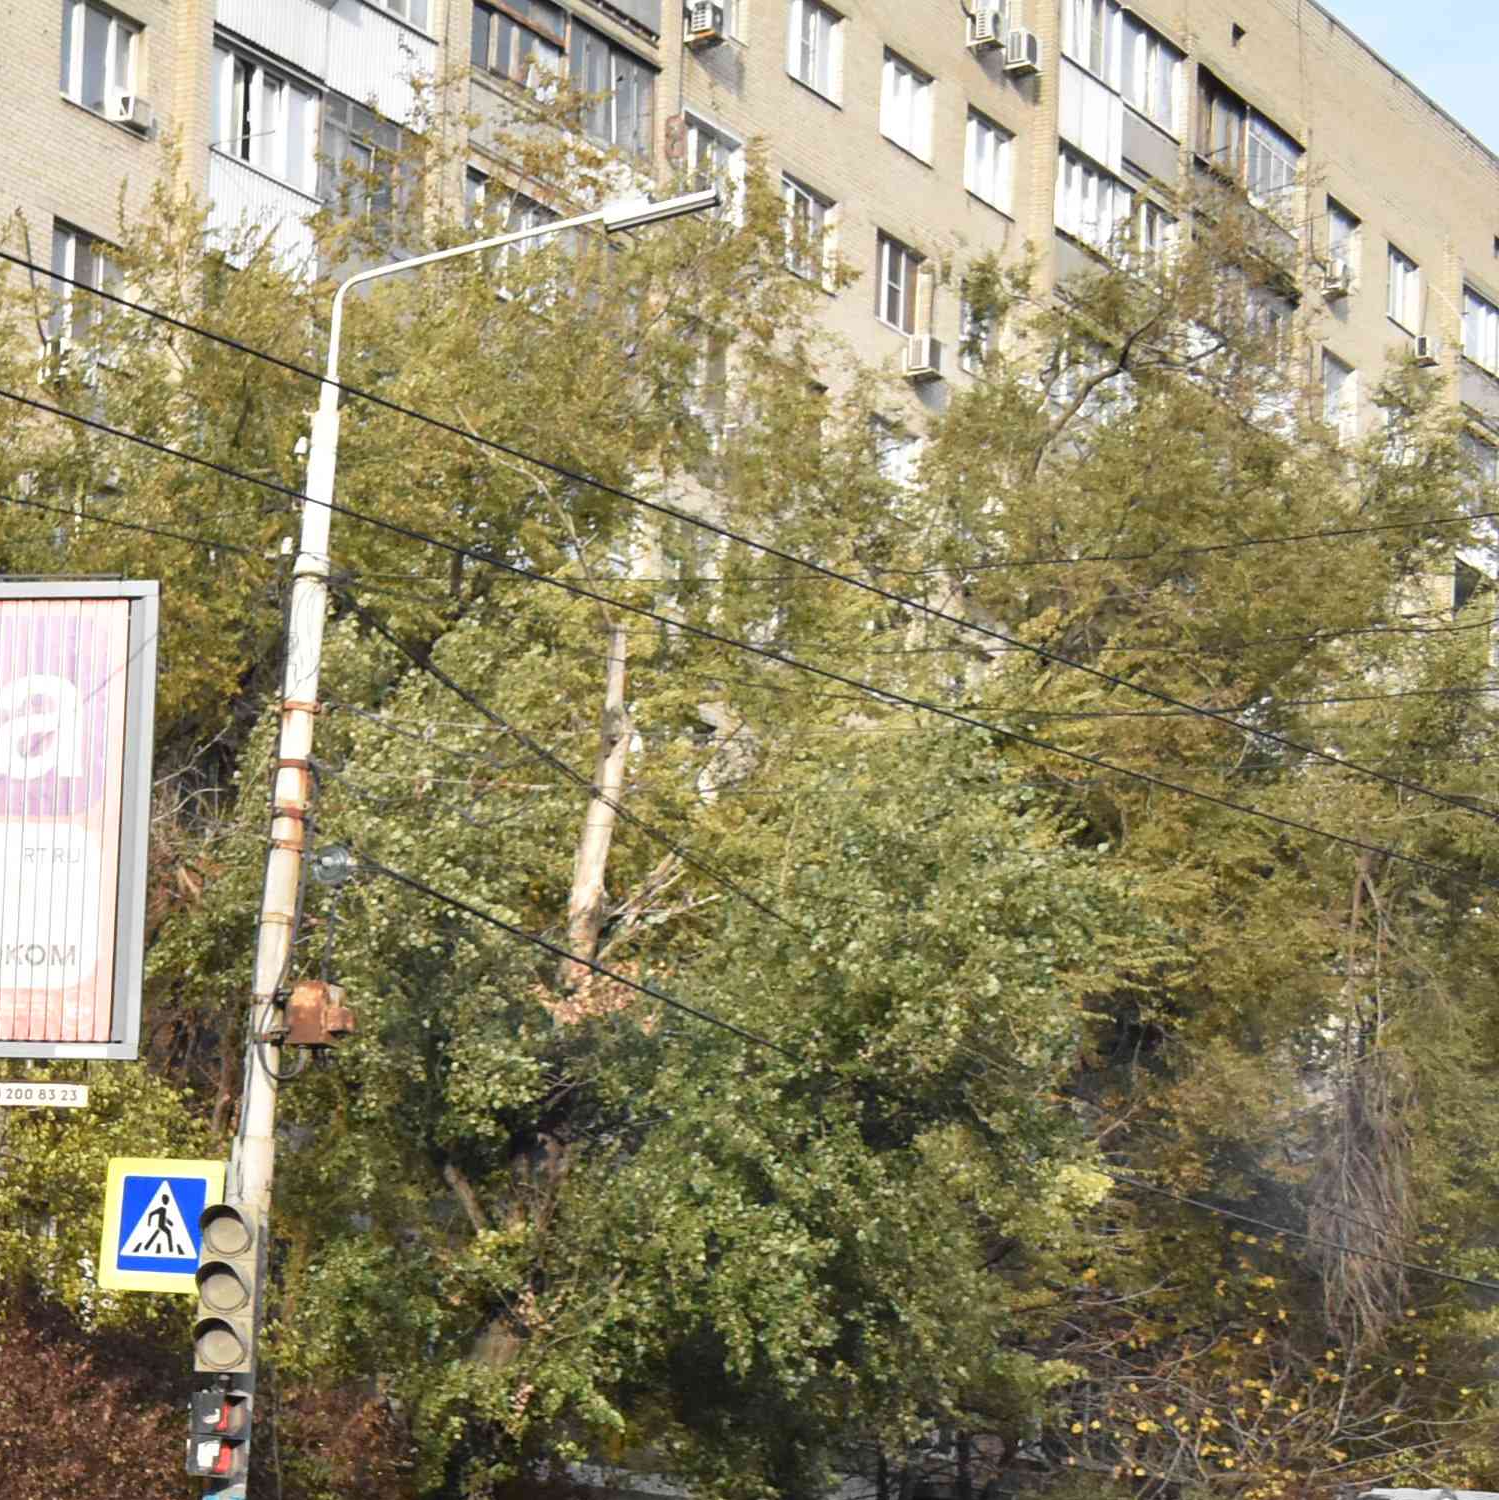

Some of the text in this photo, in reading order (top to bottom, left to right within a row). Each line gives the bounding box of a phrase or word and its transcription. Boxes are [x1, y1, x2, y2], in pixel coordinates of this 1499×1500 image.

[5, 1087, 34, 1101] 200
[37, 1088, 57, 1101] 83
[60, 1089, 79, 1101] 23
